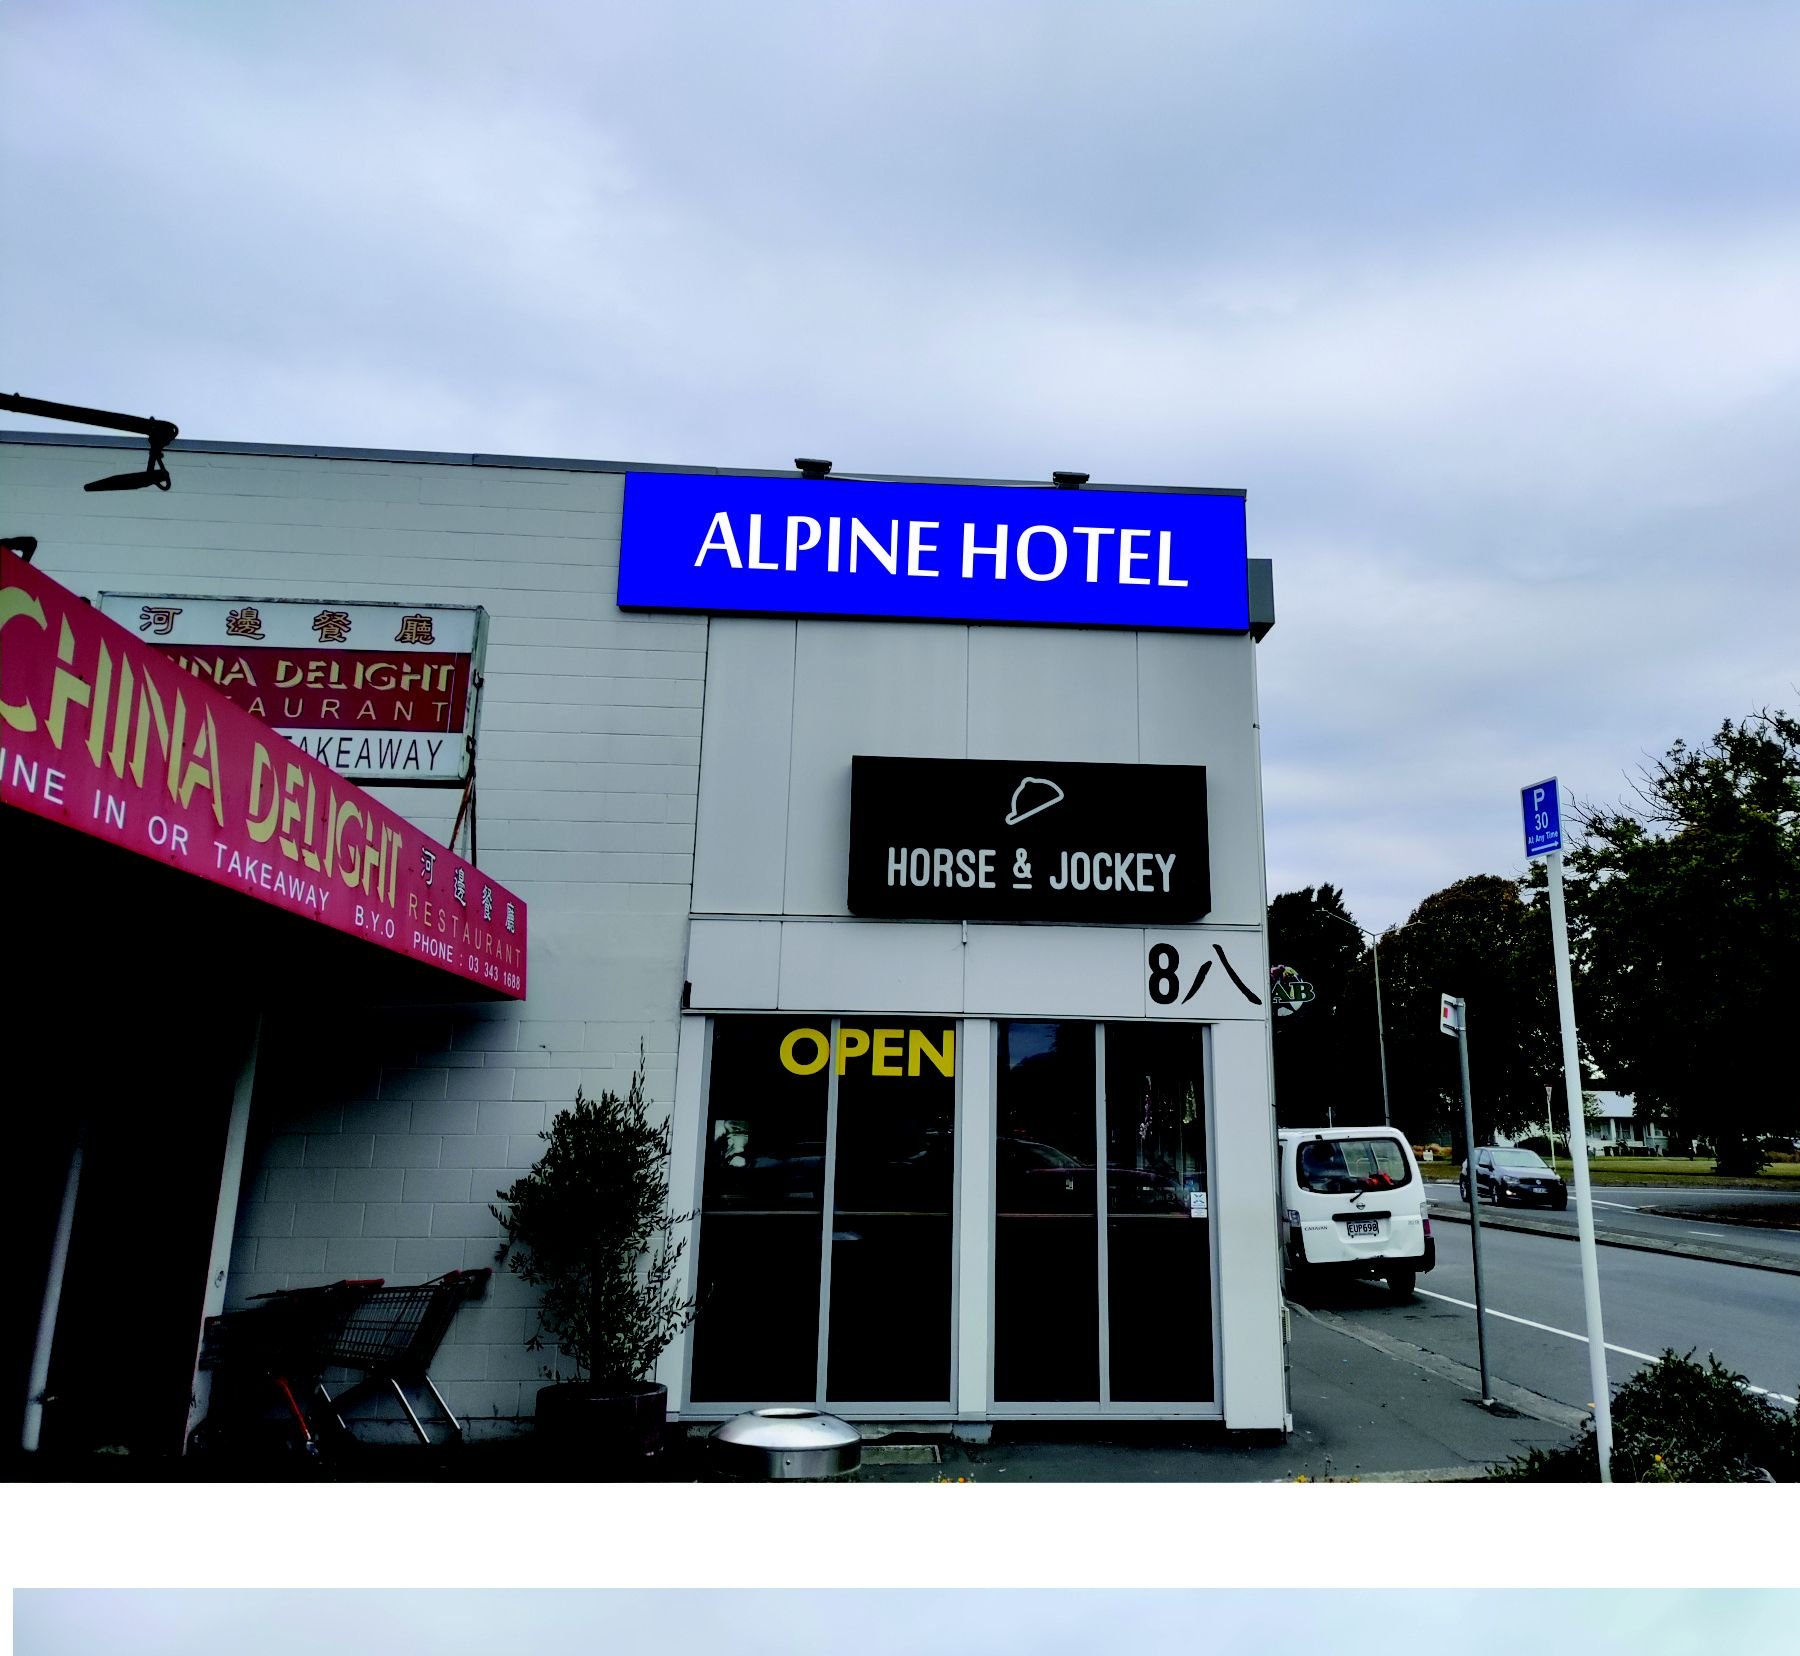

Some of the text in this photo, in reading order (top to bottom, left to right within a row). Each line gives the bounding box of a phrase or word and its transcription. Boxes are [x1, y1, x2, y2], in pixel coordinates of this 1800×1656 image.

[694, 511, 1189, 588] ALPINE HOTEL
[274, 658, 456, 692] DELIGHT
[225, 695, 449, 722] AURANT
[0, 586, 403, 909] CHINA DELIGHT
[283, 735, 443, 771] KEAWAY
[1534, 788, 1545, 812] P
[1535, 811, 1549, 831] 30
[1546, 830, 1559, 840] Time
[93, 789, 126, 830] IN
[148, 815, 188, 855] OR
[213, 841, 330, 912] TAKEAWAY
[355, 905, 395, 939] B.Y.O
[888, 847, 1177, 892] HORSE & JOCKEY
[408, 893, 521, 969] RESTAURANT
[413, 931, 454, 963] PHONE
[468, 954, 479, 974] 03
[484, 962, 499, 982] 343
[503, 971, 521, 991] 1688
[780, 1027, 955, 1078] OPEN
[1349, 1221, 1379, 1233] EUP698
